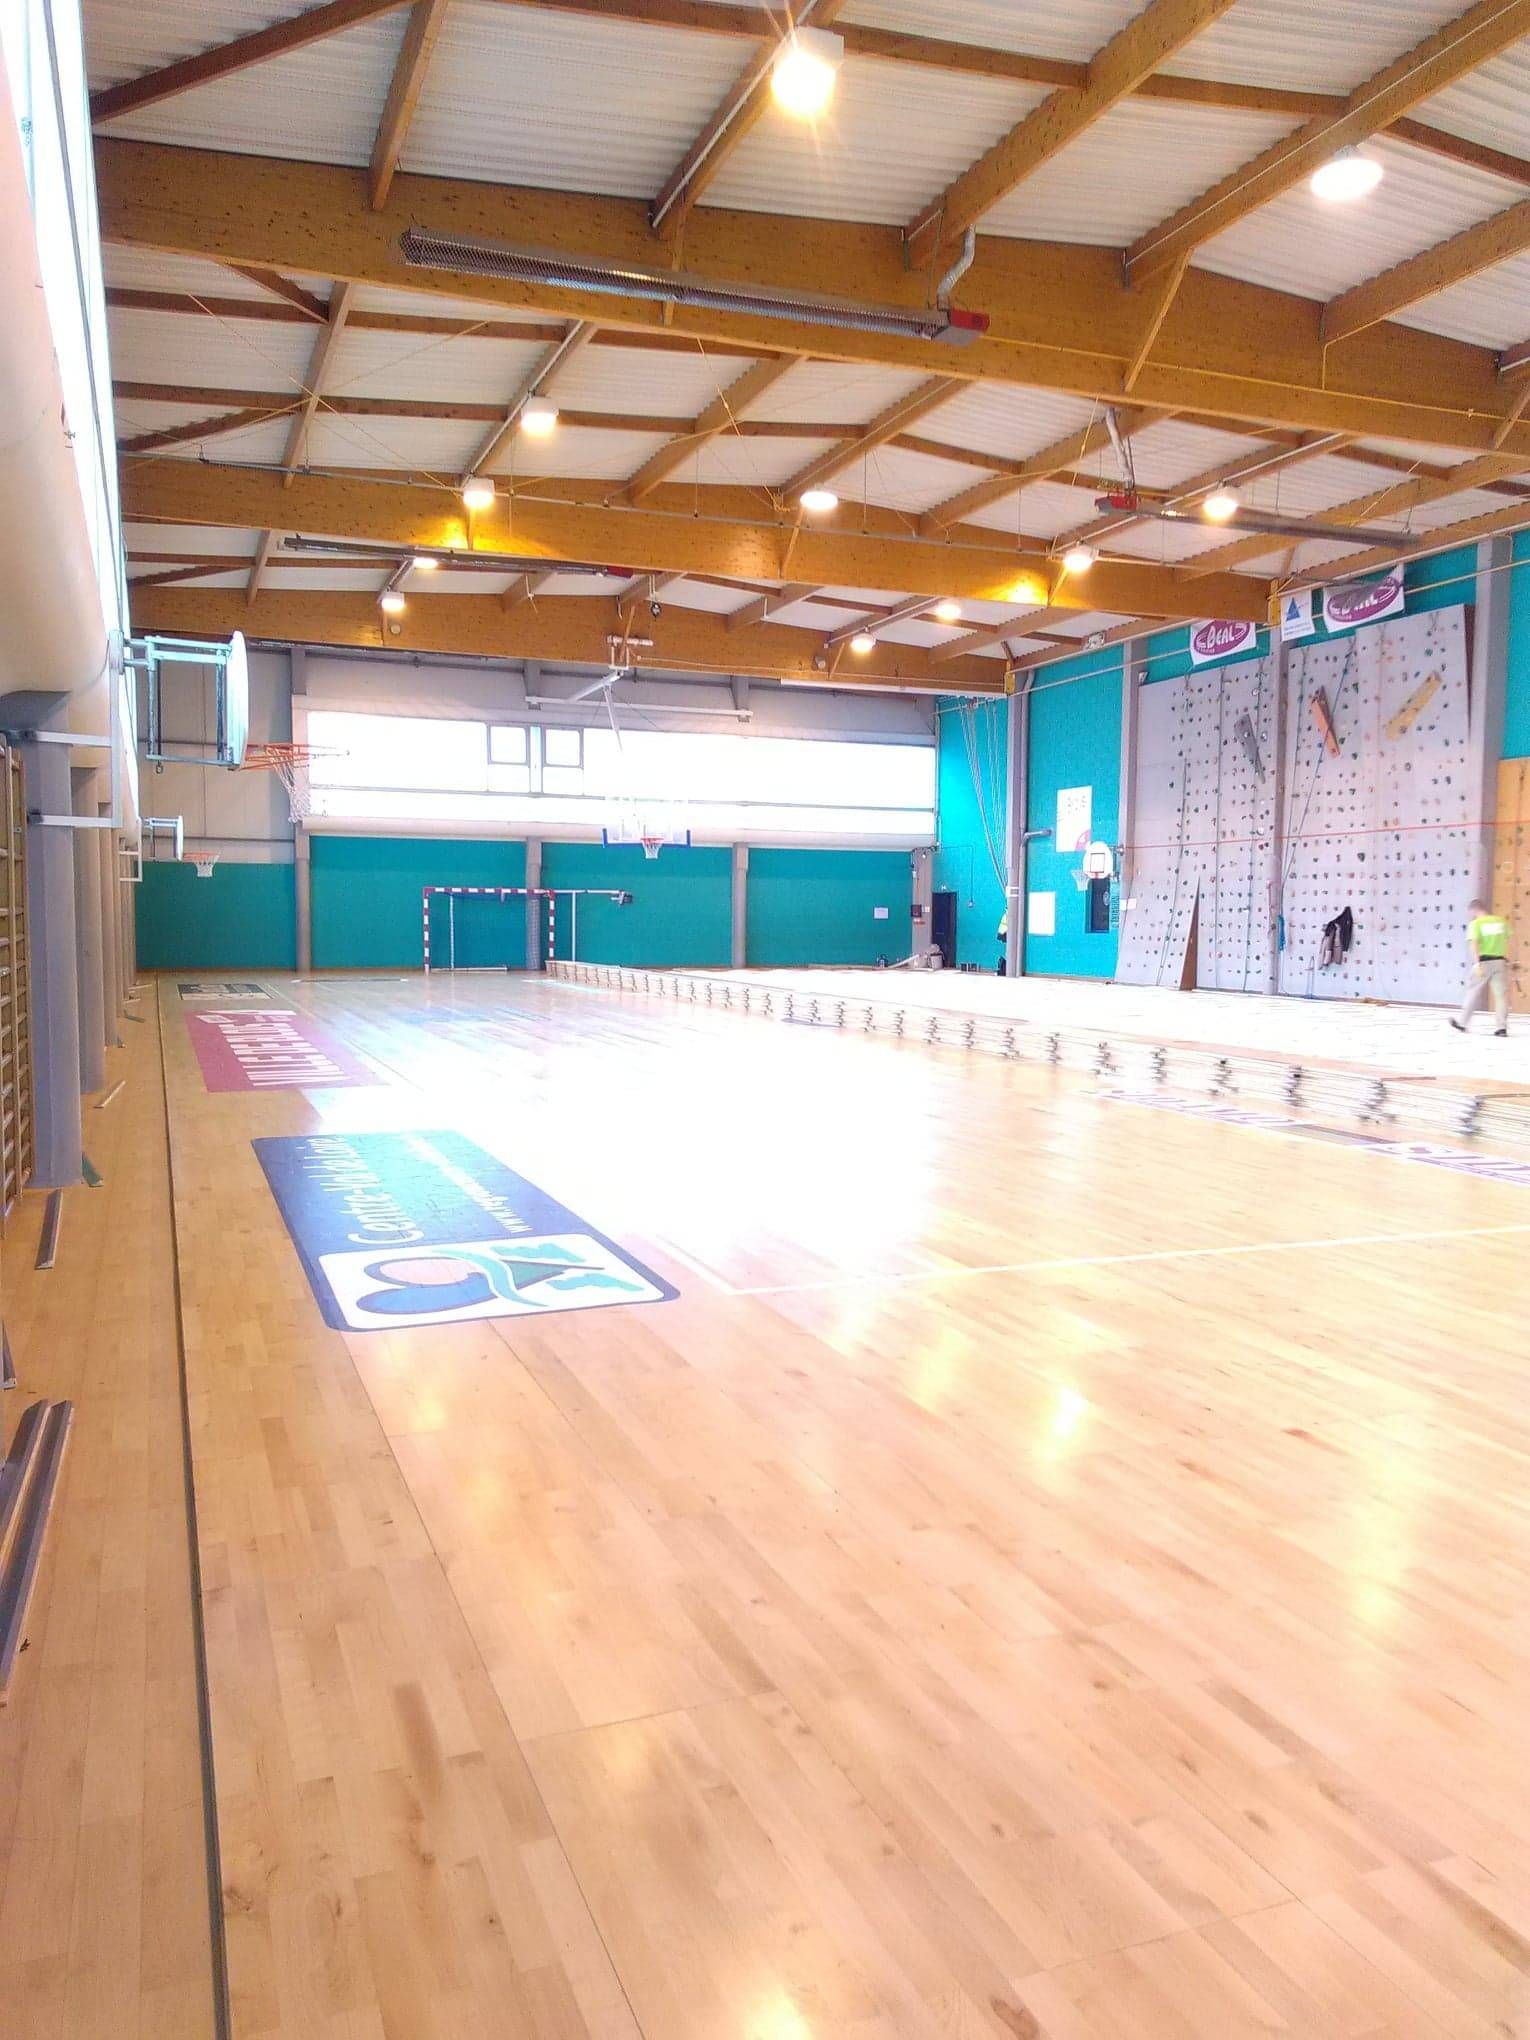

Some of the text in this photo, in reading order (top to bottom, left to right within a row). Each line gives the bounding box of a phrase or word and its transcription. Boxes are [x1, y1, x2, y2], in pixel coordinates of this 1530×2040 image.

[218, 1022, 304, 1043] BLOIS
[229, 1042, 318, 1055] DE
[237, 1053, 352, 1087] VILLE
[296, 1136, 363, 1160] Loire
[308, 1173, 424, 1245] Centre-Val
